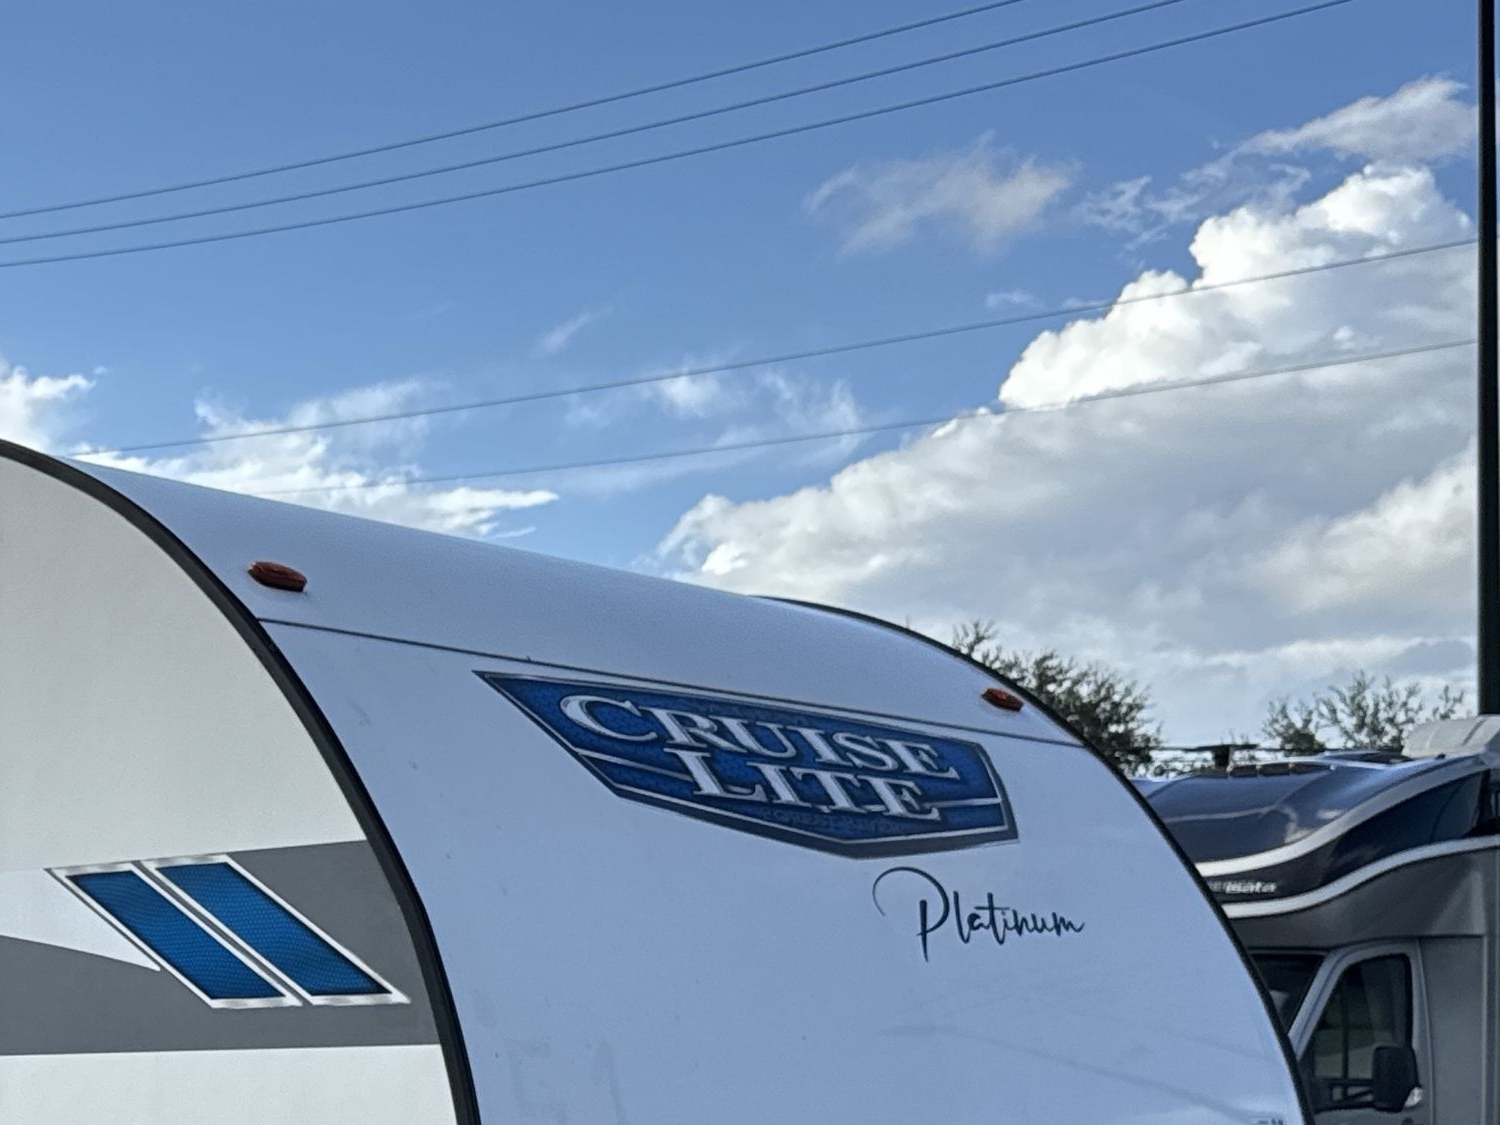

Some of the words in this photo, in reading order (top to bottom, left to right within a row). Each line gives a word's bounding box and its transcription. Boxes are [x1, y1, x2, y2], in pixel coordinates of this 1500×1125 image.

[560, 694, 960, 781] CRUISE
[663, 747, 941, 822] LITE
[872, 866, 1085, 962] Platinum
